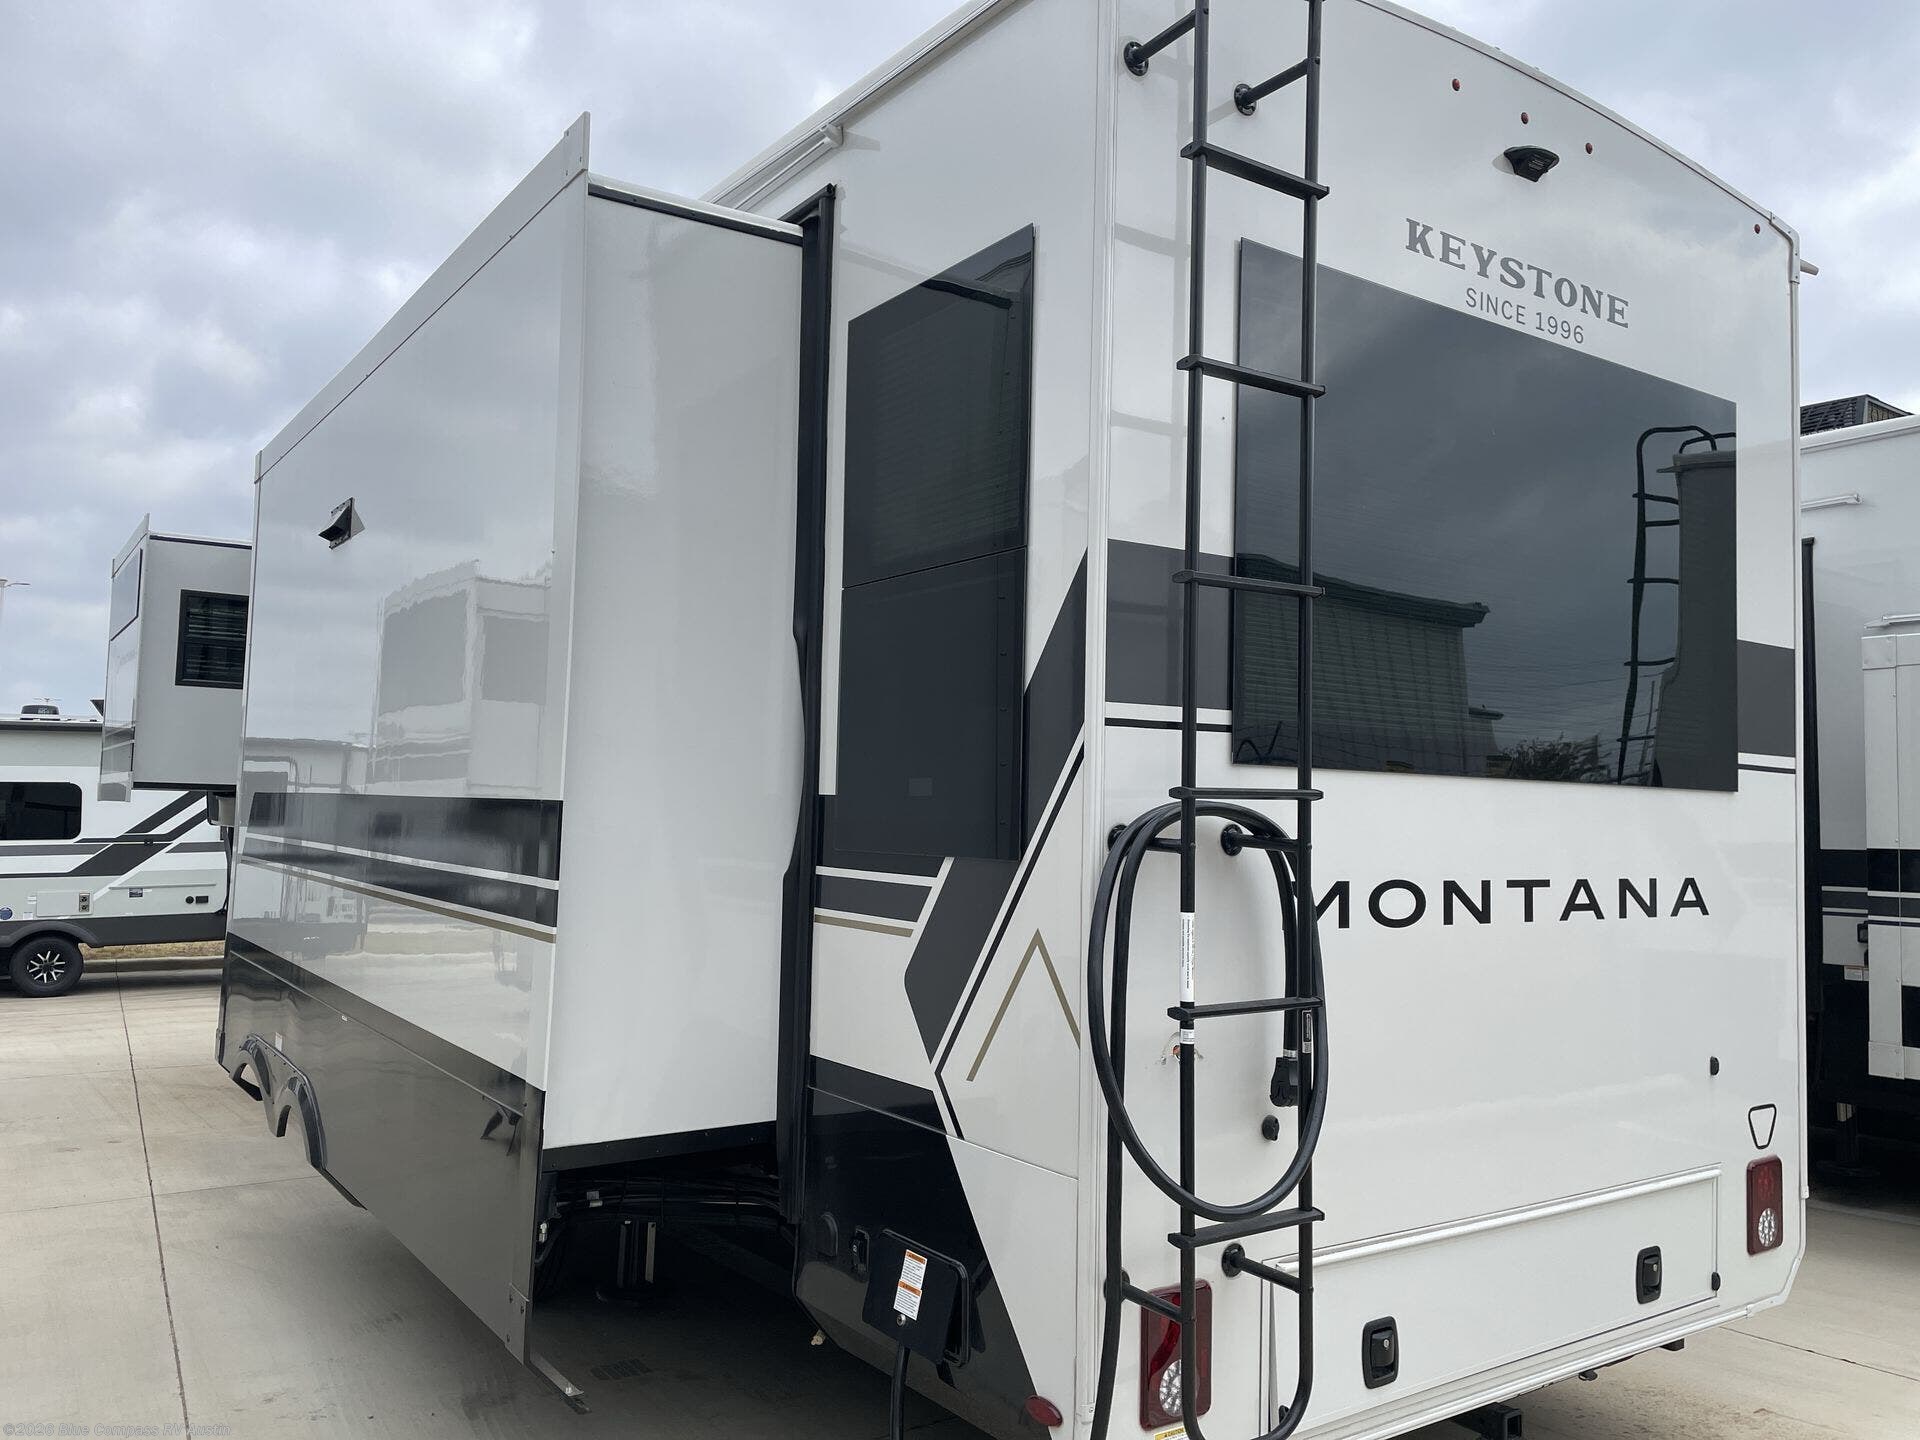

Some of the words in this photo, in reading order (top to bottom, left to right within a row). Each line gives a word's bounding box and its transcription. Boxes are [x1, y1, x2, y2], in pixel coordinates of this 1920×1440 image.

[1405, 217, 1630, 329] KEYSTONE
[1465, 286, 1526, 326] SINCE
[1535, 311, 1584, 344] 1996
